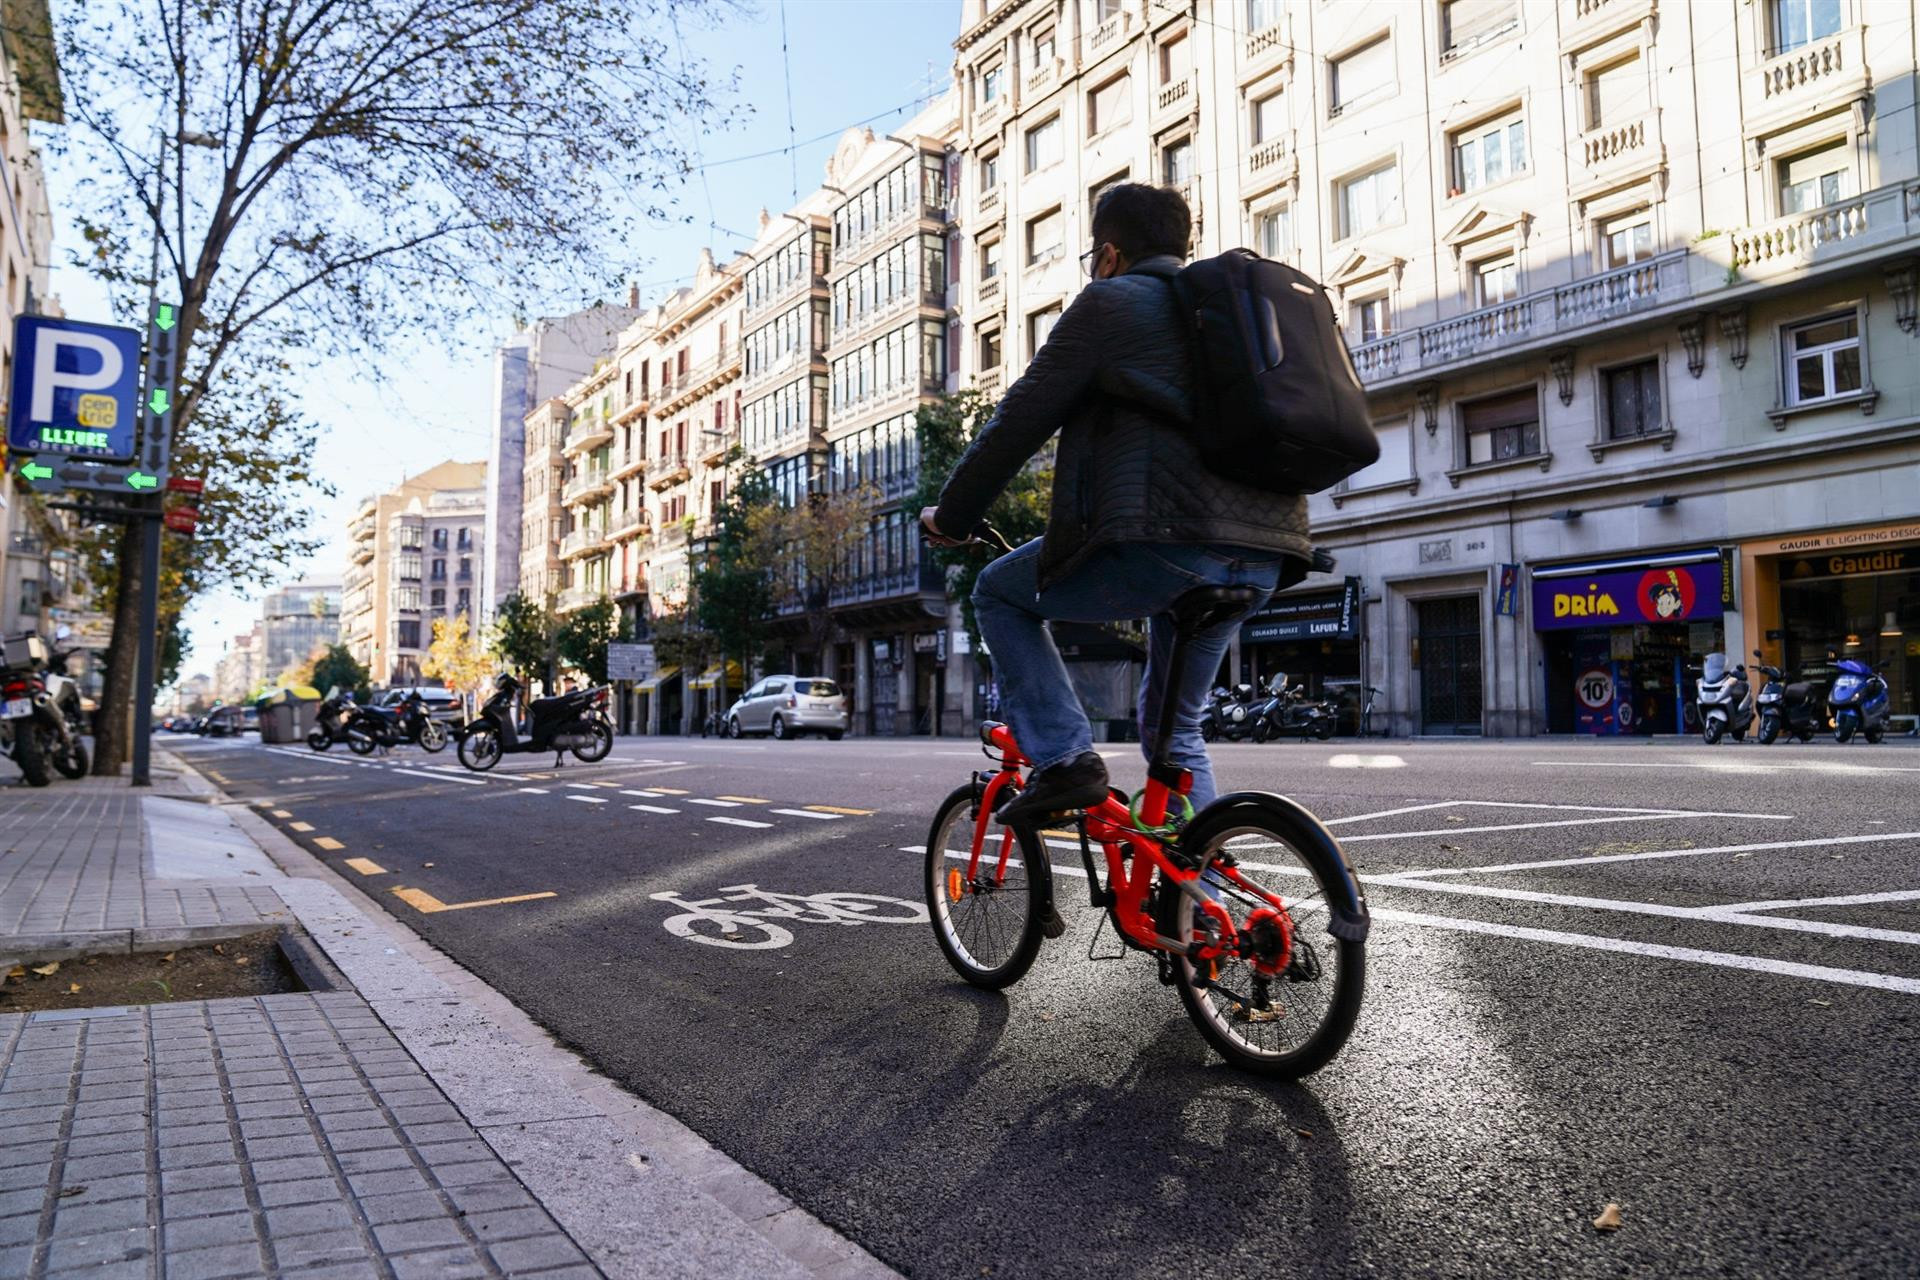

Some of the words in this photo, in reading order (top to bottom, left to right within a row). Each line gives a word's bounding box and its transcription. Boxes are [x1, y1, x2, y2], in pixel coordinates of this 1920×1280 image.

[30, 327, 124, 423] P
[81, 397, 115, 411] cen
[82, 410, 114, 425] tric
[42, 428, 108, 448] LLIURE
[1779, 539, 1821, 551] GAUDIR
[1826, 537, 1835, 546] EL
[1839, 531, 1888, 545] LIGHTING
[1828, 552, 1905, 575] Gaudir
[1722, 559, 1730, 603] Gaudir
[1341, 586, 1353, 632] LAFUENTE
